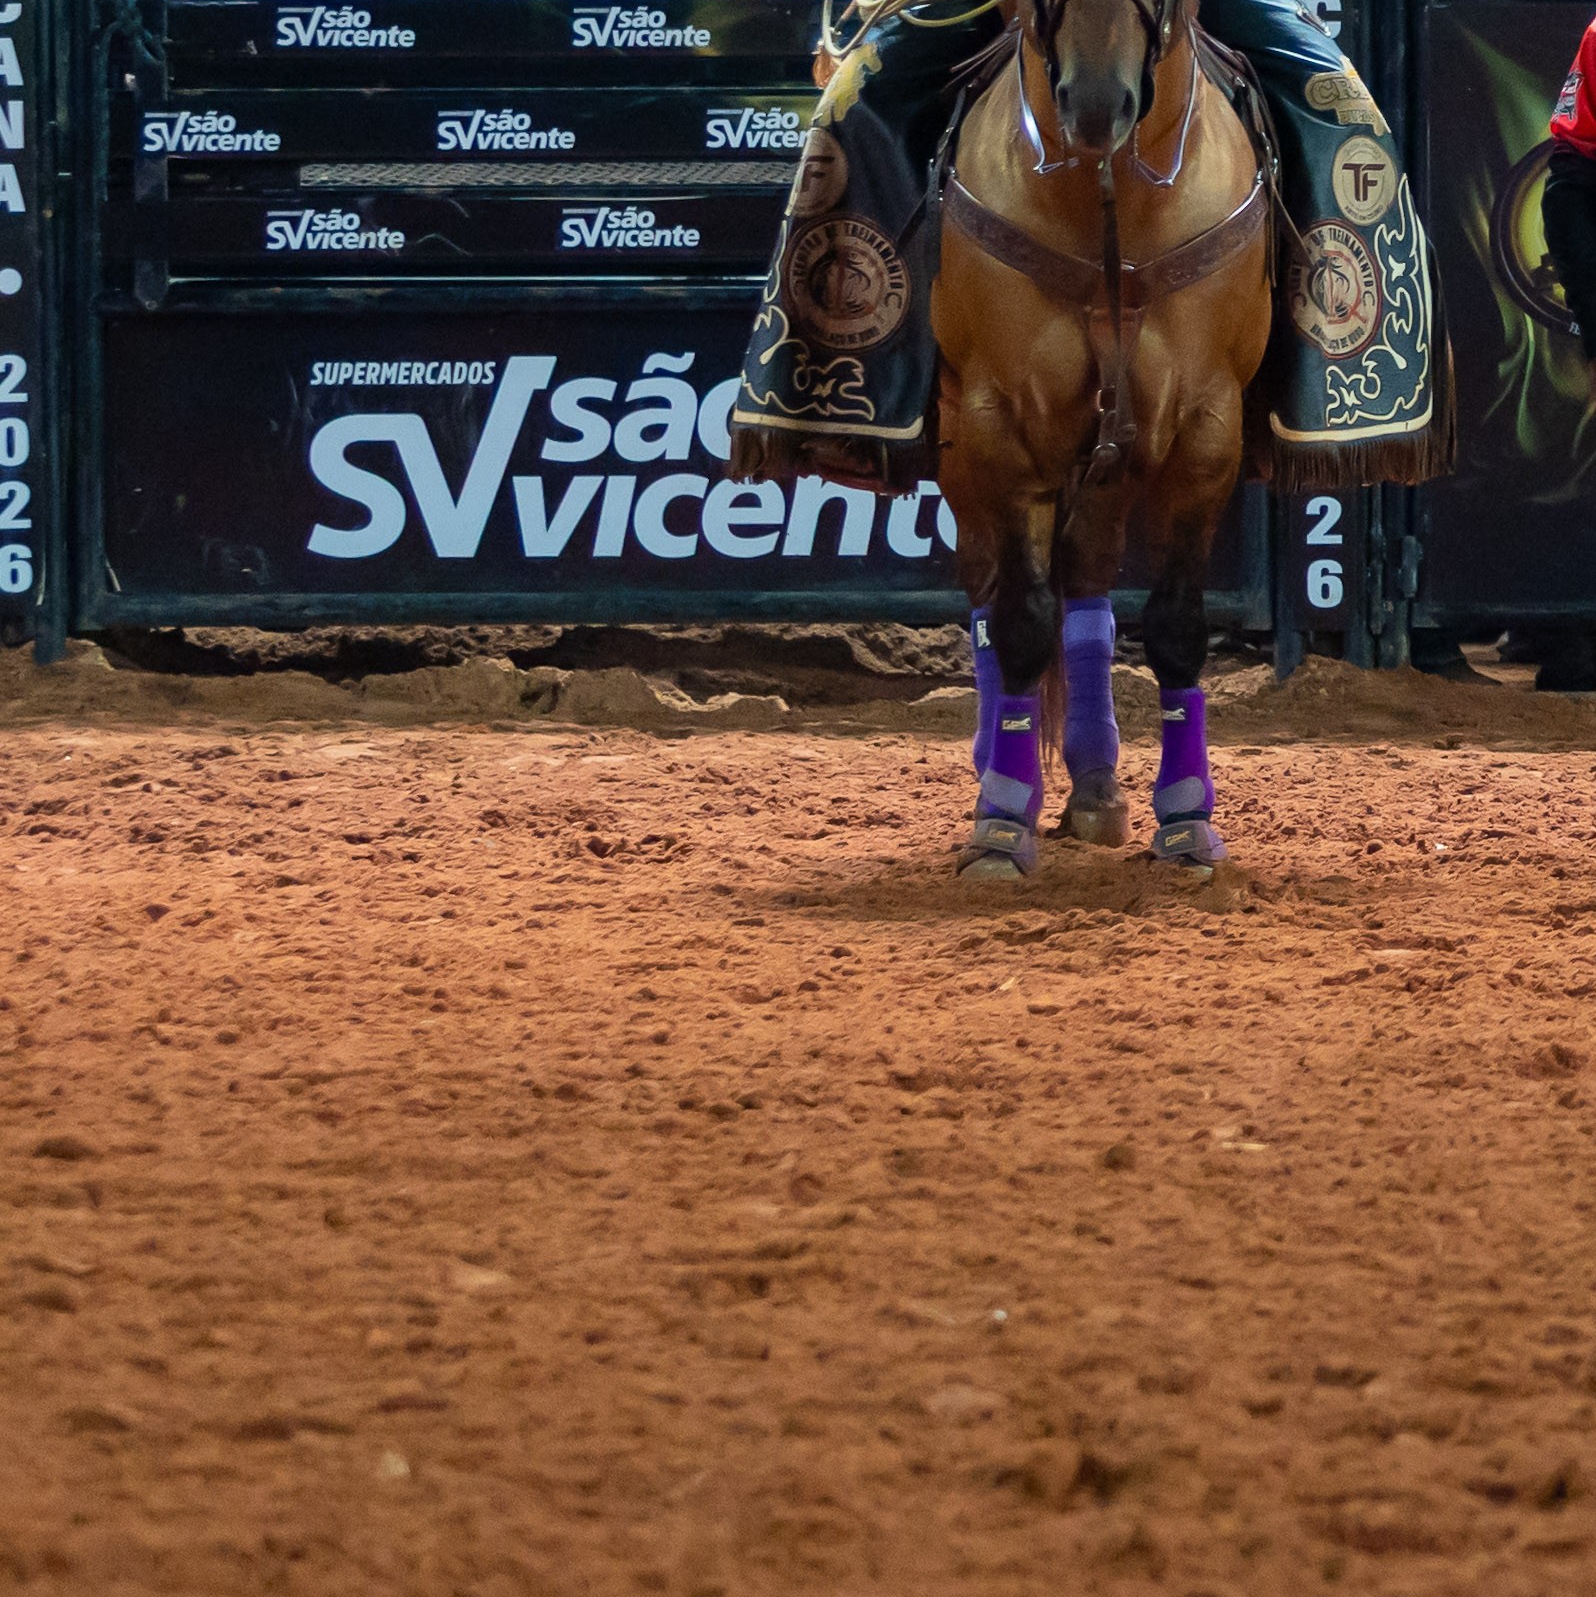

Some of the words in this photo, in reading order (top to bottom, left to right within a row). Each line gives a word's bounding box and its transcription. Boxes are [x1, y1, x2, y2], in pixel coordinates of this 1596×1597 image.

[277, 6, 327, 48] SV
[323, 5, 371, 27] são
[572, 6, 622, 48] SV
[618, 5, 666, 27] são
[318, 27, 415, 48] vicente
[613, 27, 710, 48] vicente
[189, 109, 237, 131] são
[483, 108, 531, 130] são
[706, 107, 755, 149] SV
[752, 106, 799, 128] são
[143, 110, 193, 152] SV
[437, 109, 487, 151] SV
[478, 130, 575, 151] vicente
[746, 128, 808, 149] vicen
[184, 131, 281, 152] vicente
[1341, 163, 1386, 203] TF
[312, 208, 360, 230] são
[561, 207, 611, 248] SV
[607, 206, 655, 228] são
[266, 209, 316, 250] SV
[307, 230, 404, 250] vicente
[602, 228, 699, 248] vicente
[310, 361, 496, 386] SUPERMERCADOS
[307, 355, 557, 558] SV
[0, 354, 33, 594] 2026
[512, 473, 957, 558] vicent
[1305, 496, 1344, 609] 26
